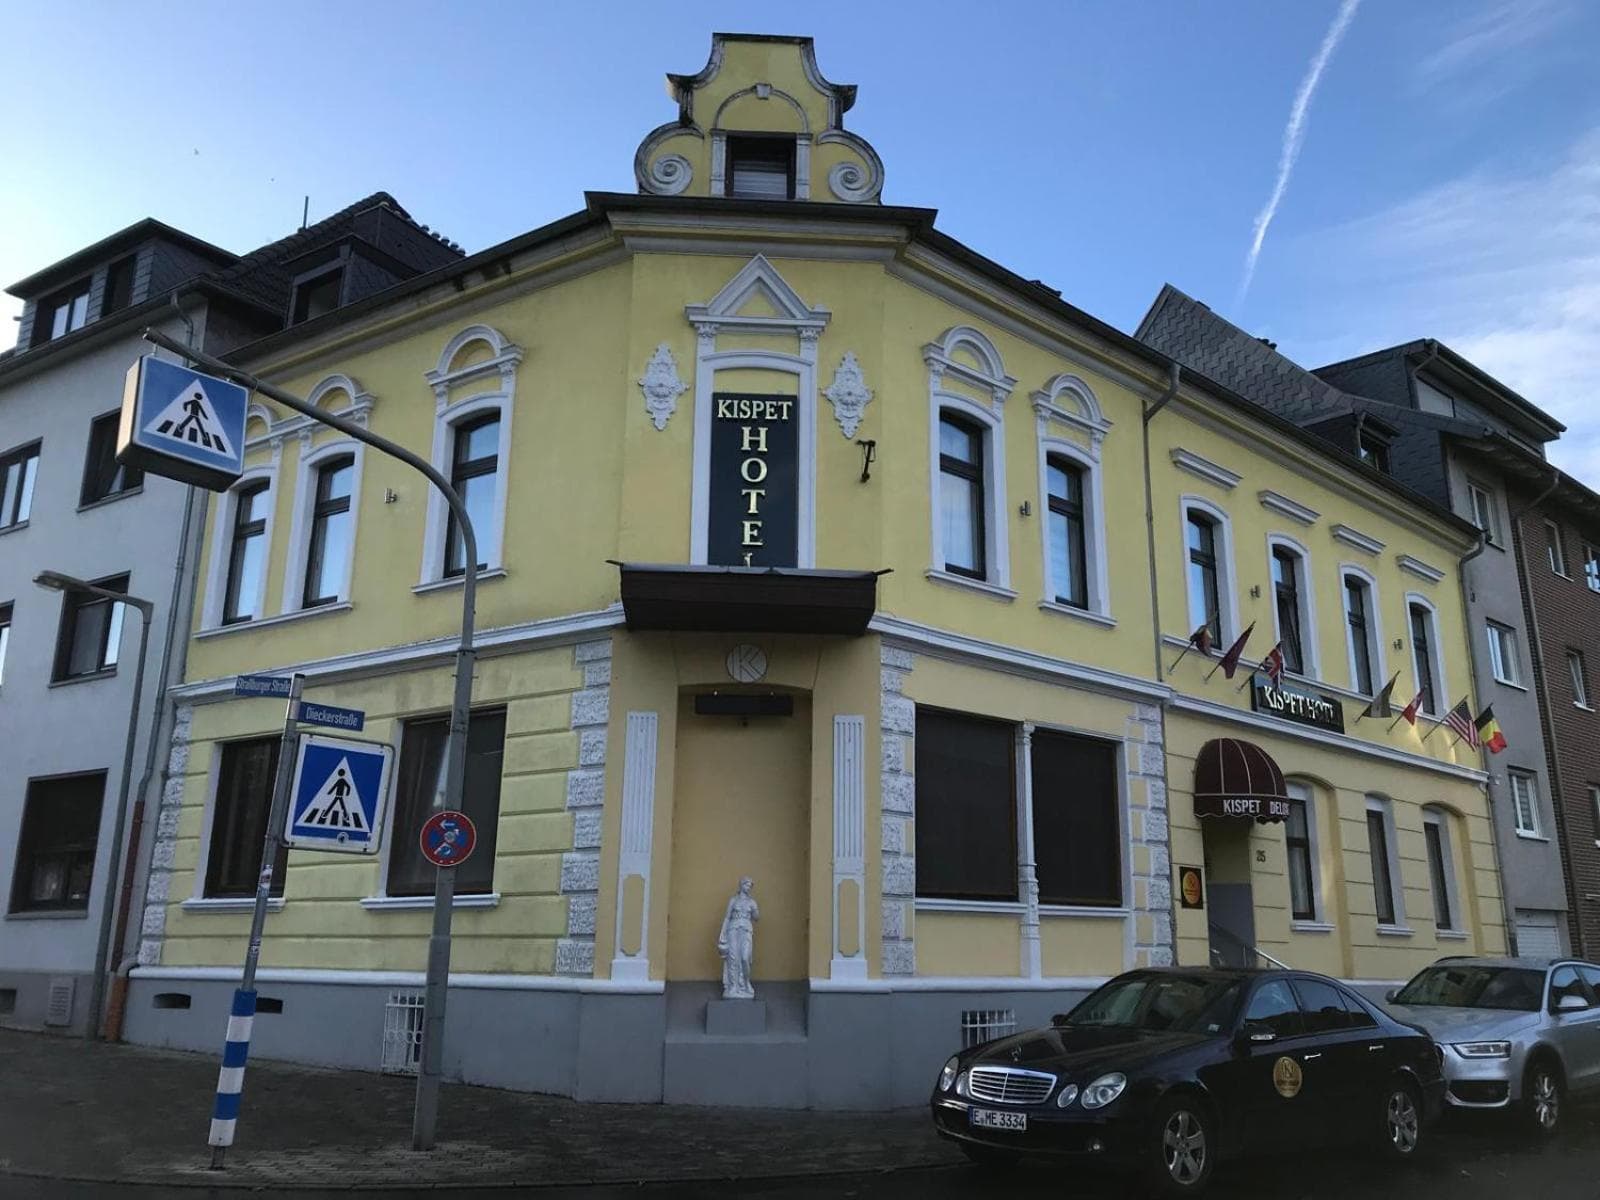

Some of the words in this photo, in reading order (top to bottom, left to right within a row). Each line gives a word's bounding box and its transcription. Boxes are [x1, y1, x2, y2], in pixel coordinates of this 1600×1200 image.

[717, 399, 793, 420] KISPET
[305, 705, 359, 726] Dieckerstraße
[1223, 799, 1261, 814] KISPET
